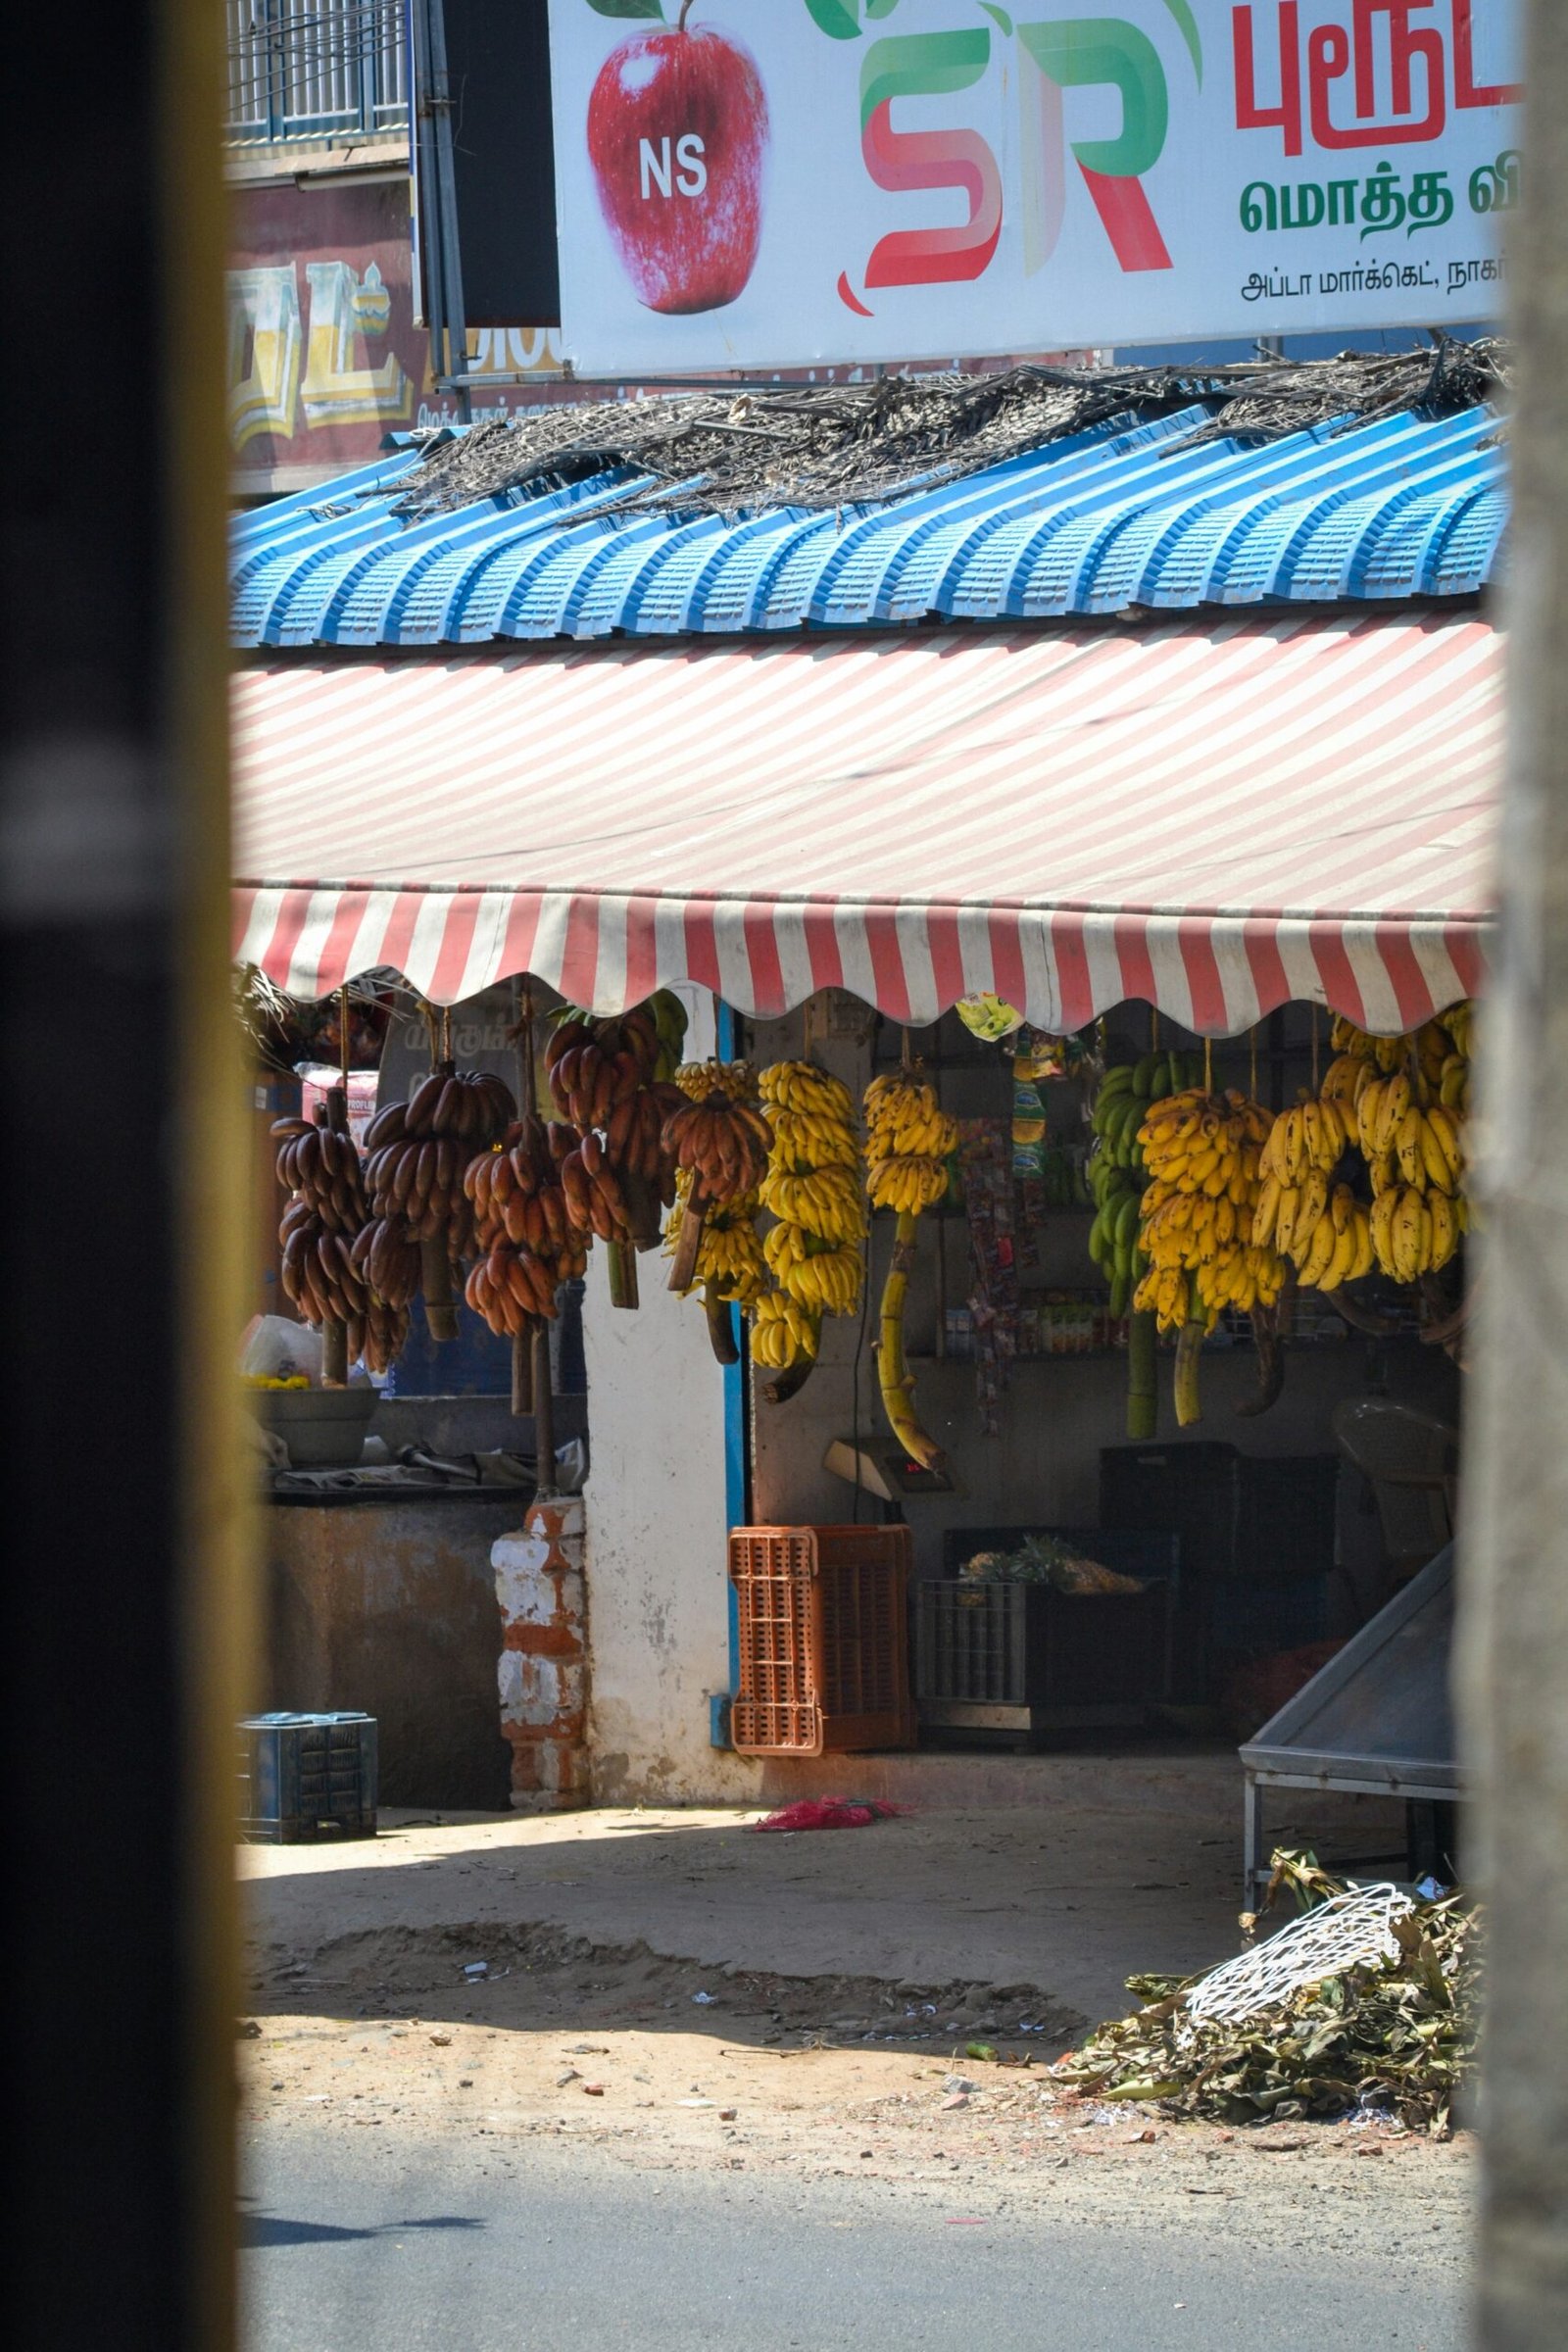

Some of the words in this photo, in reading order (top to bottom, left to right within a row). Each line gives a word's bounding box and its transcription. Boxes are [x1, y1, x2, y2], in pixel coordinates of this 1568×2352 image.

[639, 134, 708, 199] NS
[859, 18, 1174, 288] SR
[1239, 161, 1454, 244] மொத்த
[1241, 266, 1311, 302] அப்டா
[1319, 259, 1440, 292] மார்க்கெட்,
